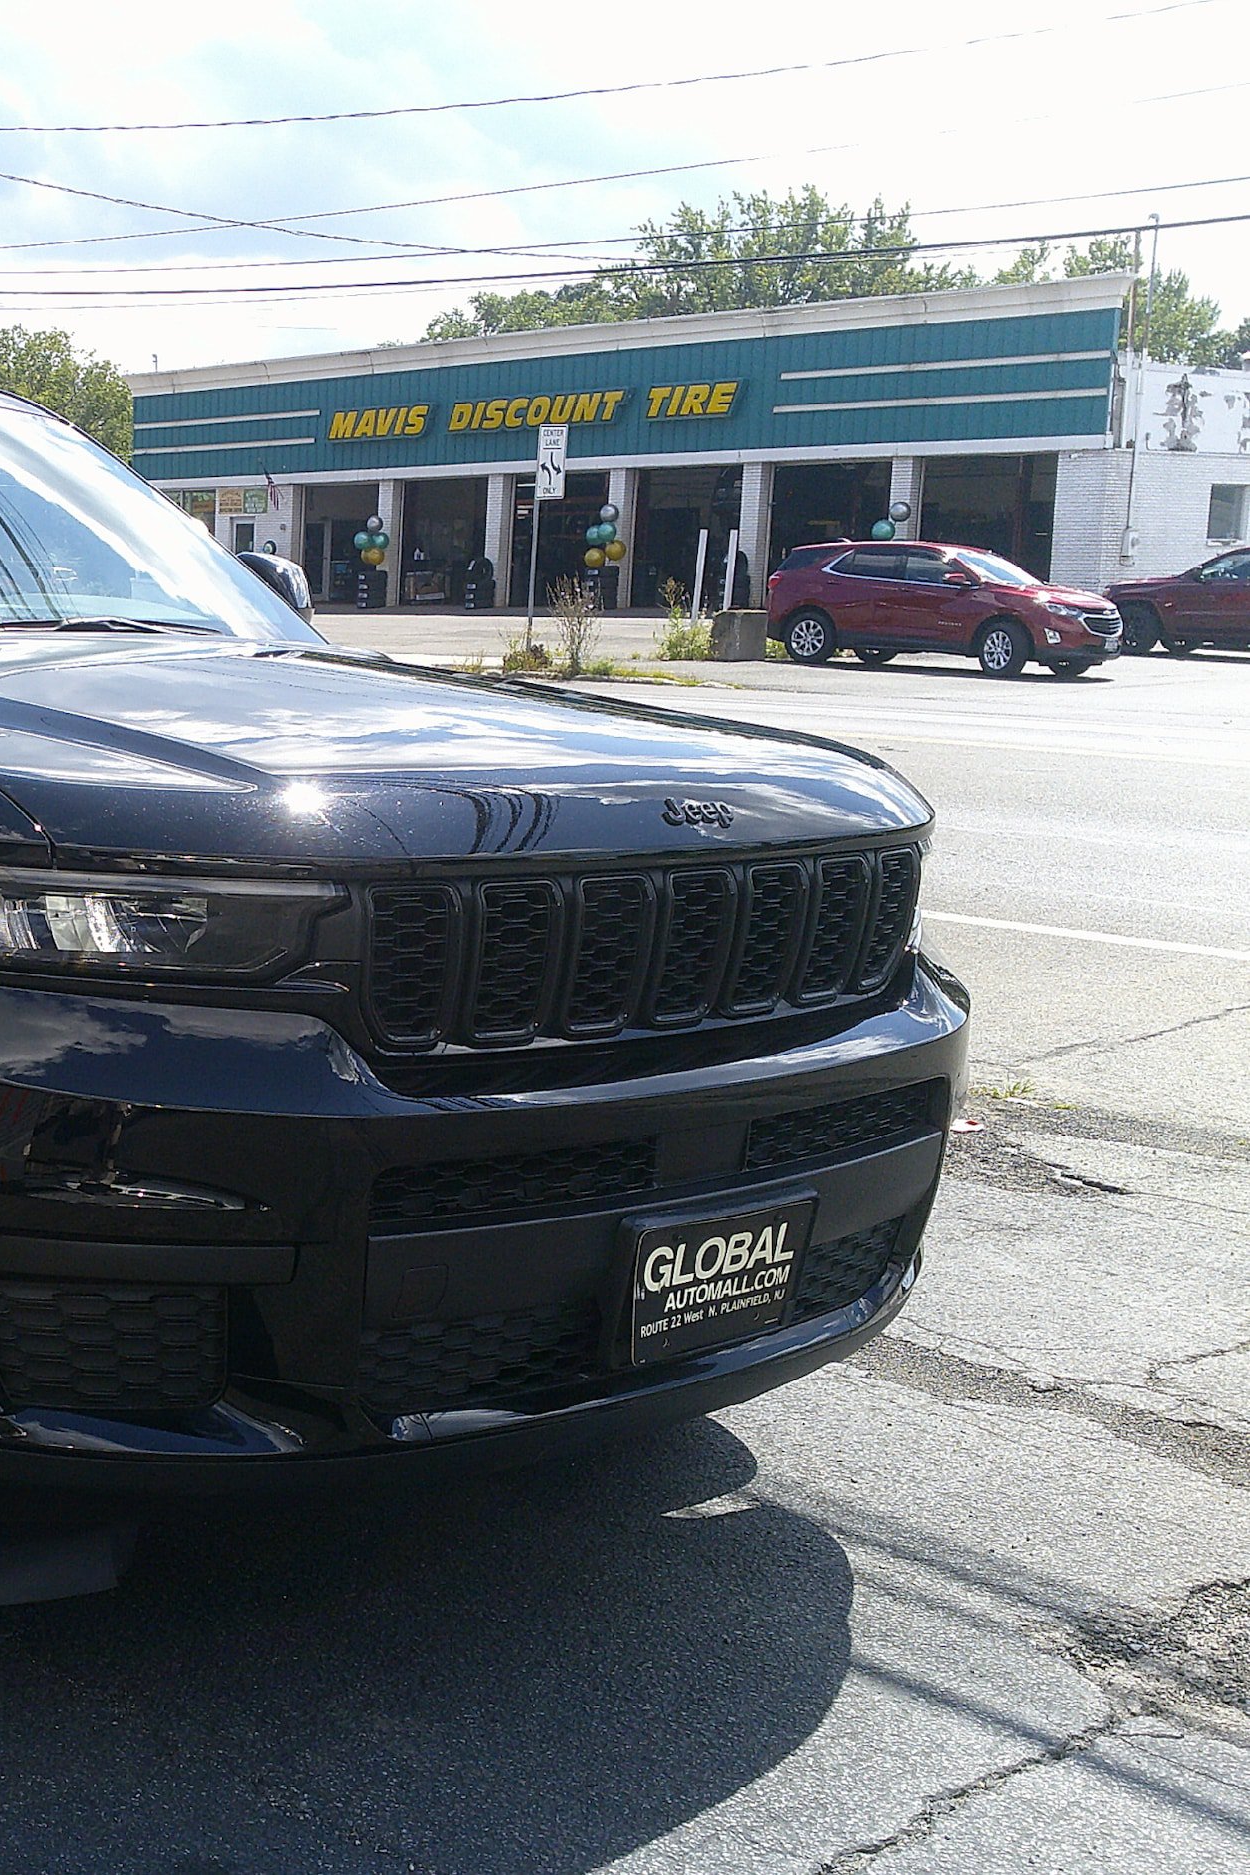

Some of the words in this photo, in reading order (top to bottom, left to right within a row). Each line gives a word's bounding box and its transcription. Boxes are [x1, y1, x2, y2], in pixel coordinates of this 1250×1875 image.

[328, 404, 429, 441] MAVIS
[448, 390, 625, 432] DISCOUNT
[646, 381, 739, 418] TIRE
[543, 429, 564, 437] CENTER
[545, 438, 560, 446] LANE
[542, 487, 557, 495] ONLY
[661, 796, 734, 828] Jeep
[643, 1222, 795, 1292] GLOBAL
[664, 1265, 791, 1313] AUTOMALL.COM
[640, 1318, 670, 1338] ROUTE
[670, 1314, 682, 1328] 22
[683, 1309, 704, 1325] West
[708, 1305, 718, 1318] N.
[720, 1294, 771, 1315] PLAINFIELD,
[773, 1289, 786, 1301] NJ
